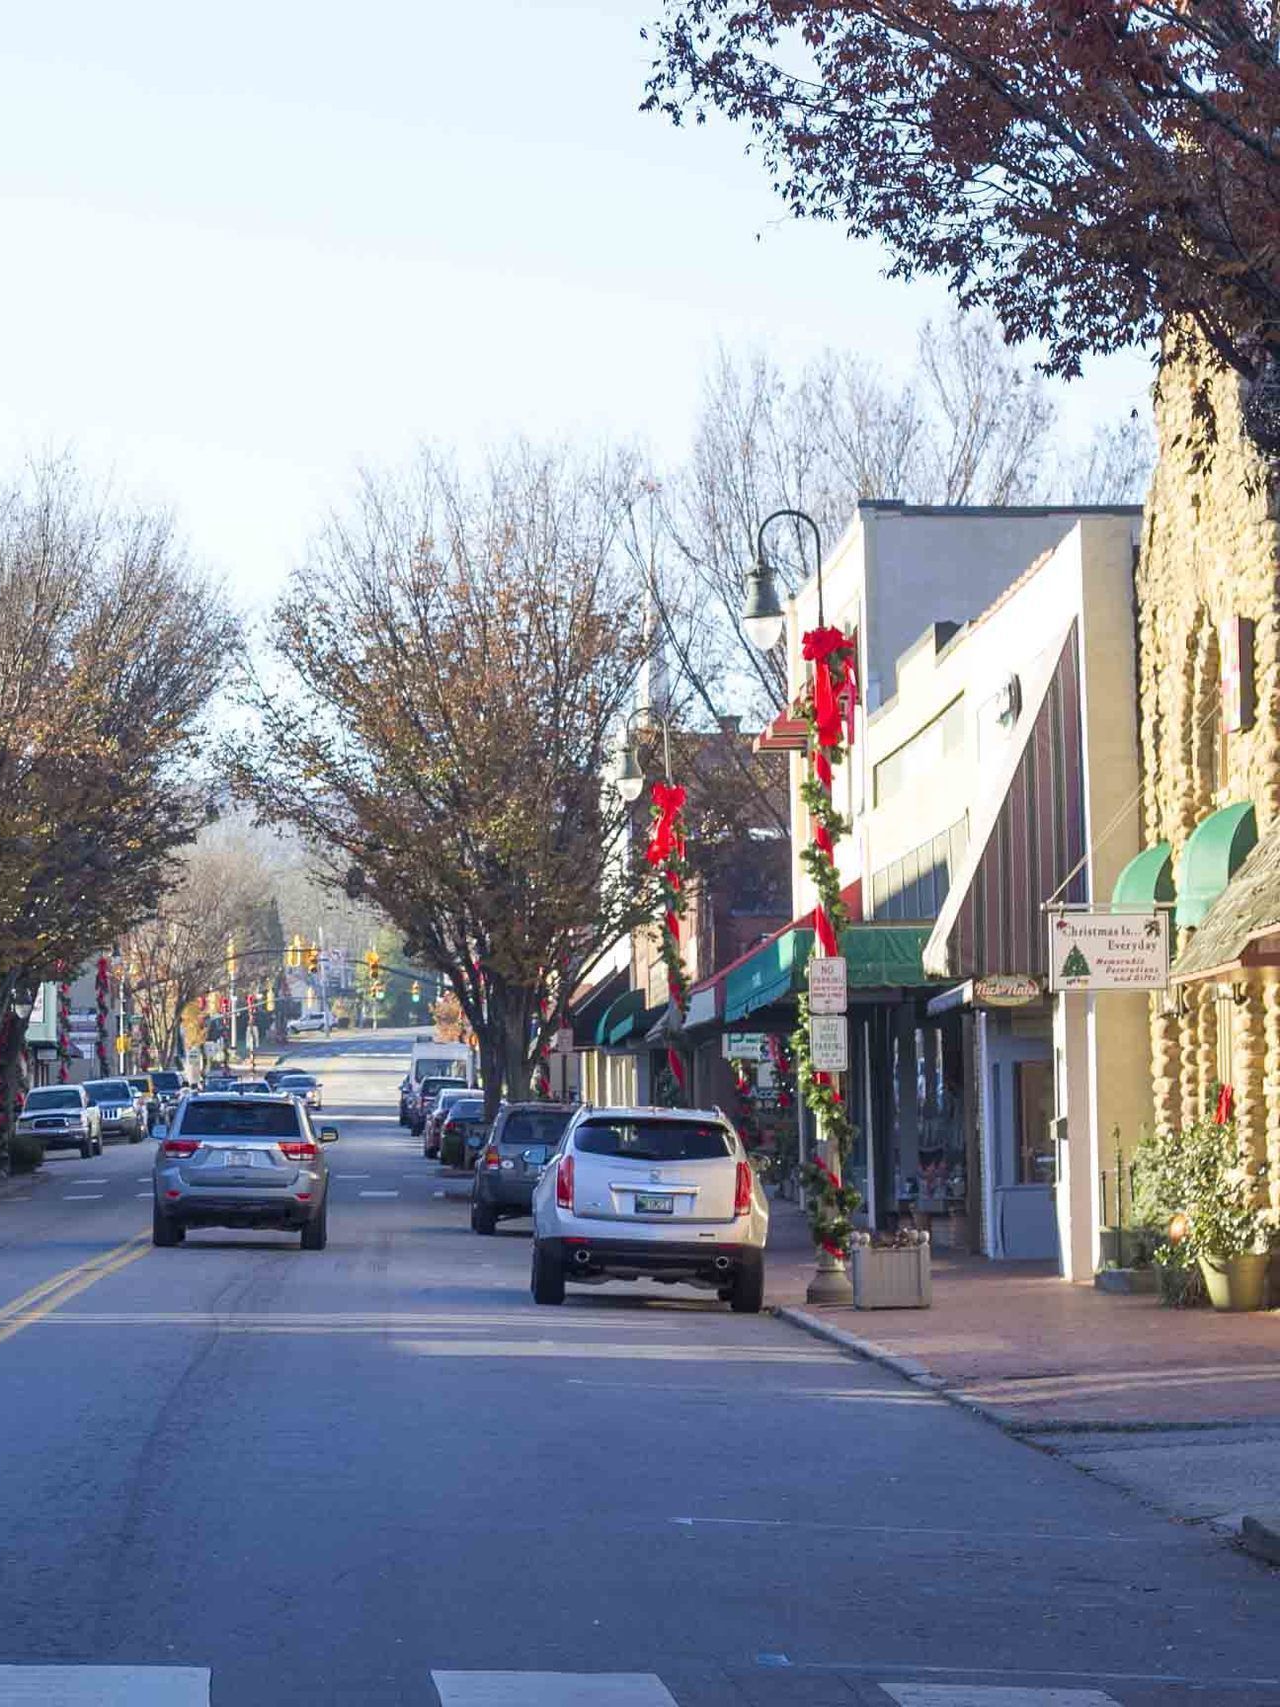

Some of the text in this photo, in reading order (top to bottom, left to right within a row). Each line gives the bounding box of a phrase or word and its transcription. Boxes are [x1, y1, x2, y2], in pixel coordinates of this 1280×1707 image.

[1062, 925, 1119, 937] Christmas
[1108, 940, 1157, 953] Everyday
[821, 965, 834, 975] NO
